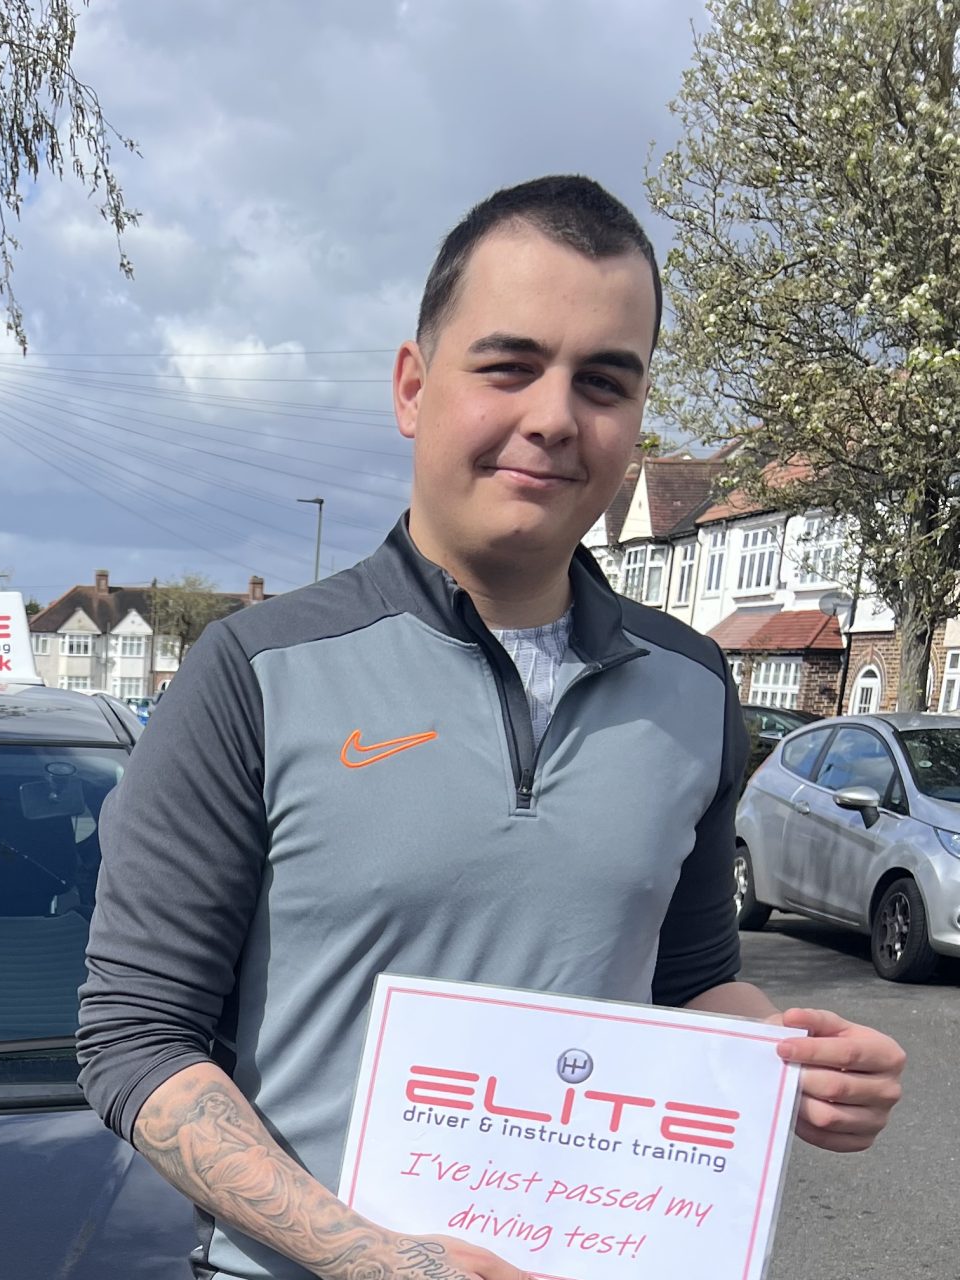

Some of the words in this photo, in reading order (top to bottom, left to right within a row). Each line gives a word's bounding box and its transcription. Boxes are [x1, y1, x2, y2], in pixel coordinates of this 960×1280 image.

[403, 1106, 470, 1131] driver
[478, 1115, 493, 1133] &
[502, 1119, 623, 1153] instructor
[631, 1137, 727, 1174] training
[405, 1064, 740, 1150] ELITE
[400, 1150, 471, 1183] I've
[470, 1159, 544, 1194] just
[546, 1178, 664, 1214] passed
[664, 1198, 713, 1228] my
[447, 1203, 554, 1253] driving
[562, 1226, 647, 1260] test!
